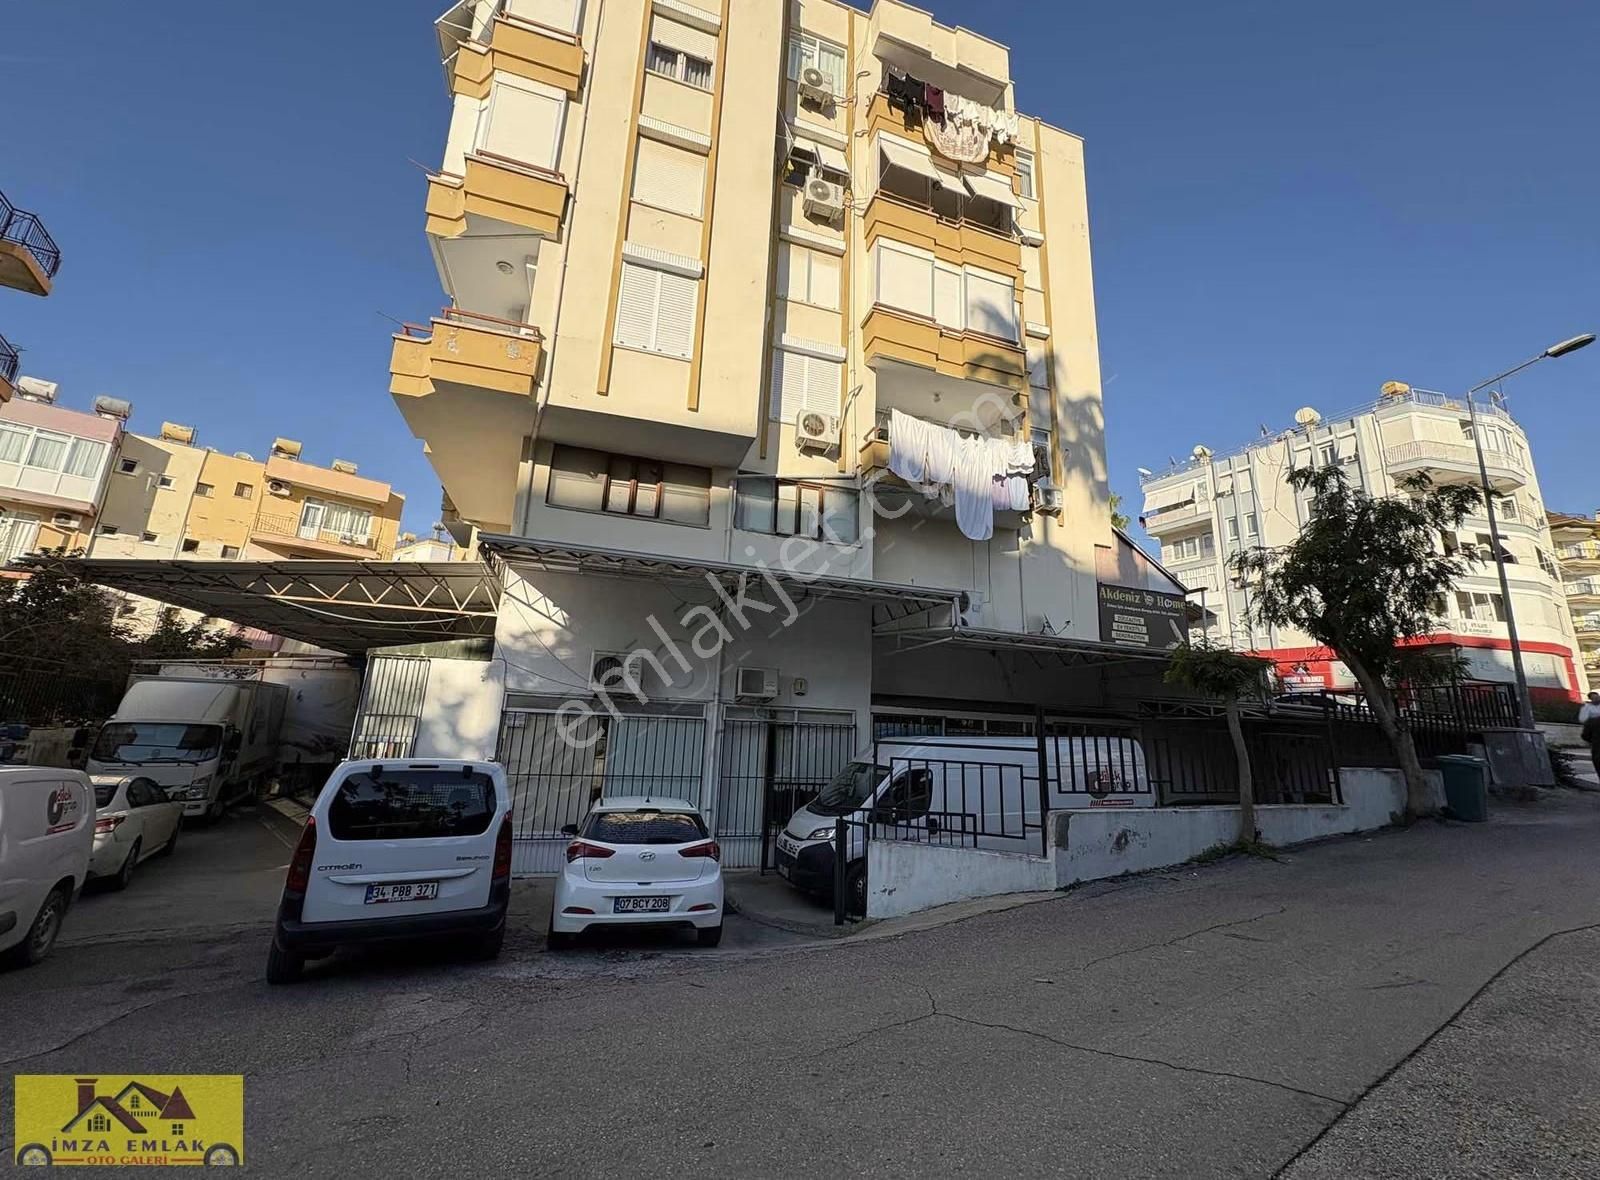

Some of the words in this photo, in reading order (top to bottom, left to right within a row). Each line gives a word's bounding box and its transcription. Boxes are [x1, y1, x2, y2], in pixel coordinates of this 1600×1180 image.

[1100, 587, 1141, 604] Akdeniz
[1157, 596, 1186, 609] Home
[373, 886, 386, 899] 34
[391, 885, 412, 897] PBB
[416, 883, 436, 896] 371
[620, 899, 631, 909] 07
[632, 899, 650, 909] BCY
[652, 898, 668, 908] 208
